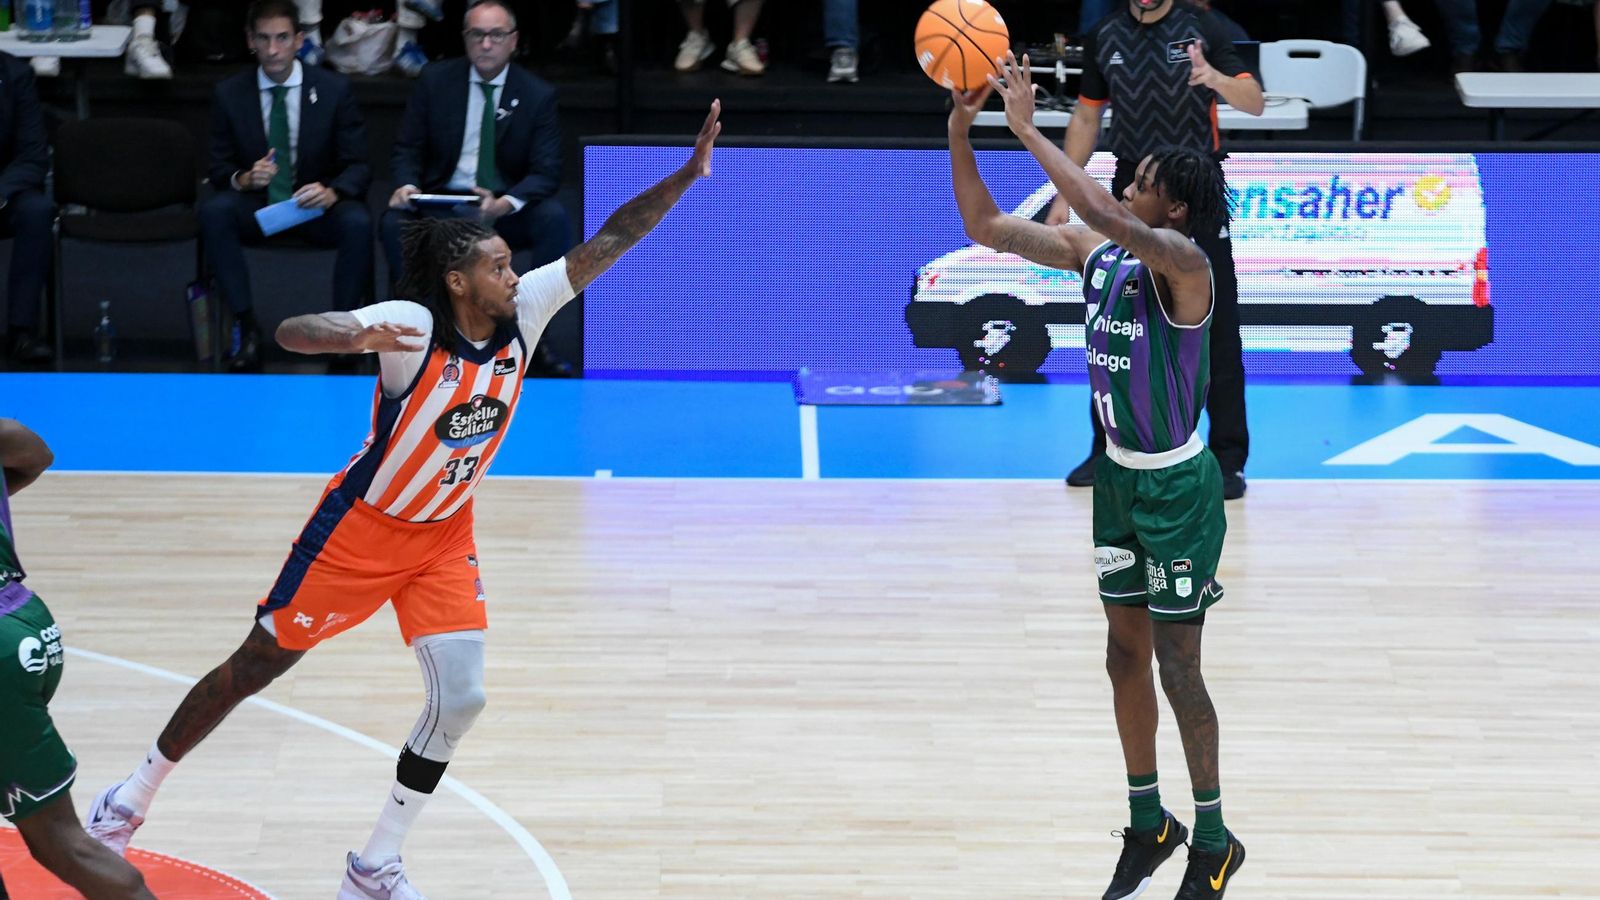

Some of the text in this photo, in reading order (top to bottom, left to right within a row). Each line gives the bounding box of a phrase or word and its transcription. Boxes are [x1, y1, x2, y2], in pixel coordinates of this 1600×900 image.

[1093, 314, 1144, 341] nicaja
[1094, 390, 1117, 428] 11
[449, 420, 494, 439] Galicia
[440, 455, 479, 485] 33
